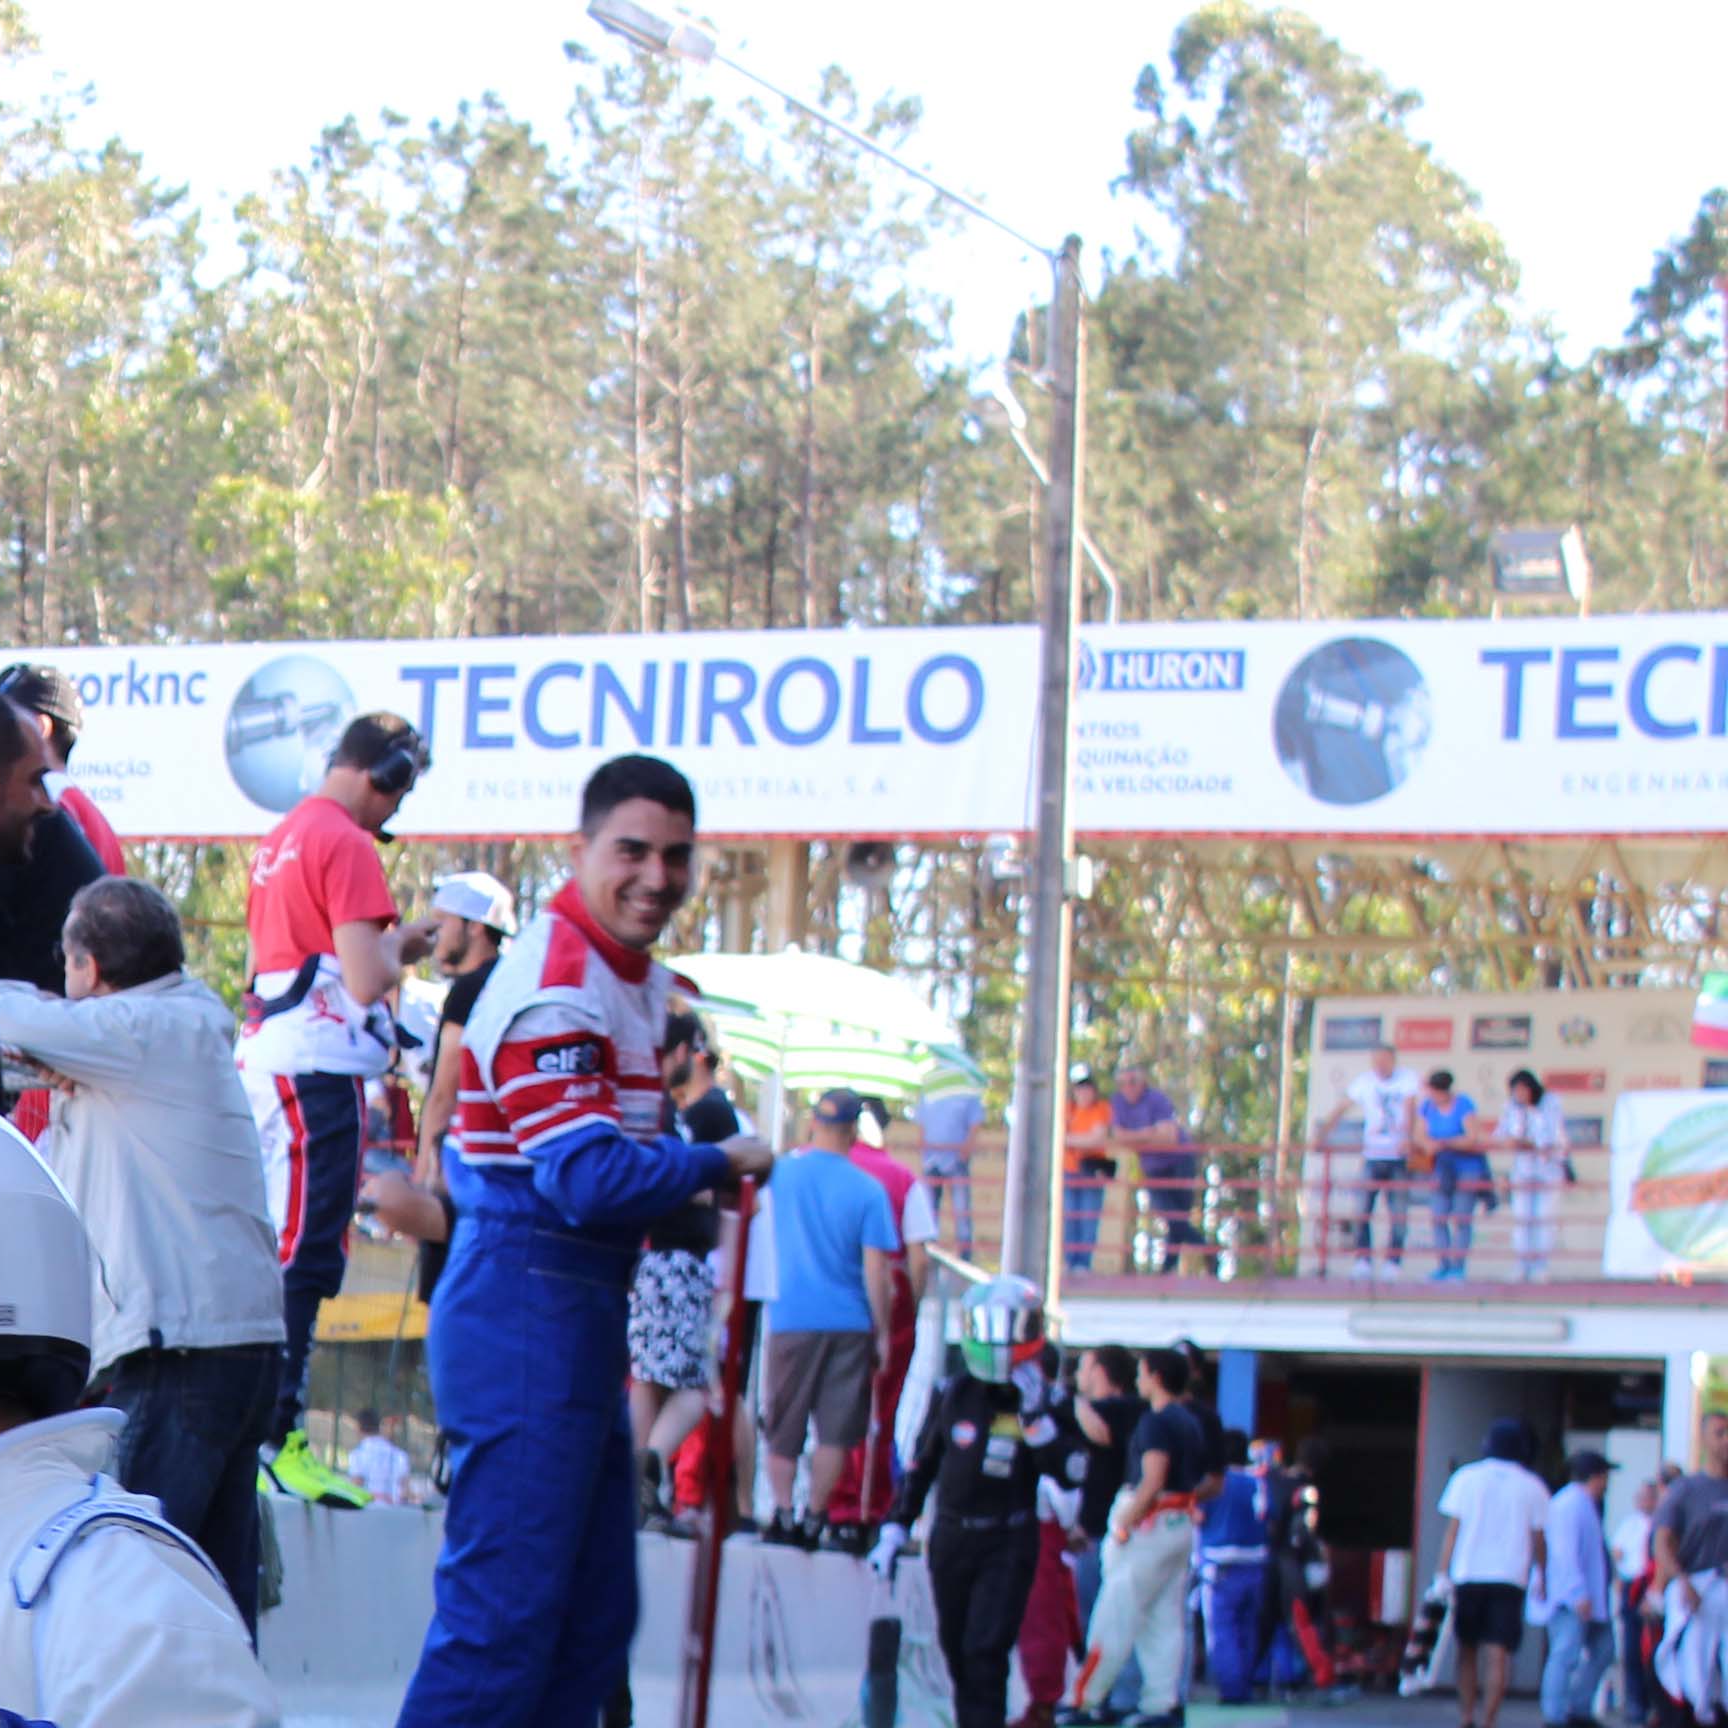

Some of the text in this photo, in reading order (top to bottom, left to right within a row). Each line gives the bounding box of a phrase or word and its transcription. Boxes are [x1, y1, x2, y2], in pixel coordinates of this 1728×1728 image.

[73, 657, 209, 706] orknc
[1111, 652, 1234, 687] HURON
[399, 653, 986, 750] TECNIROLO
[466, 778, 576, 800] ENGENH
[536, 1045, 581, 1073] elf
